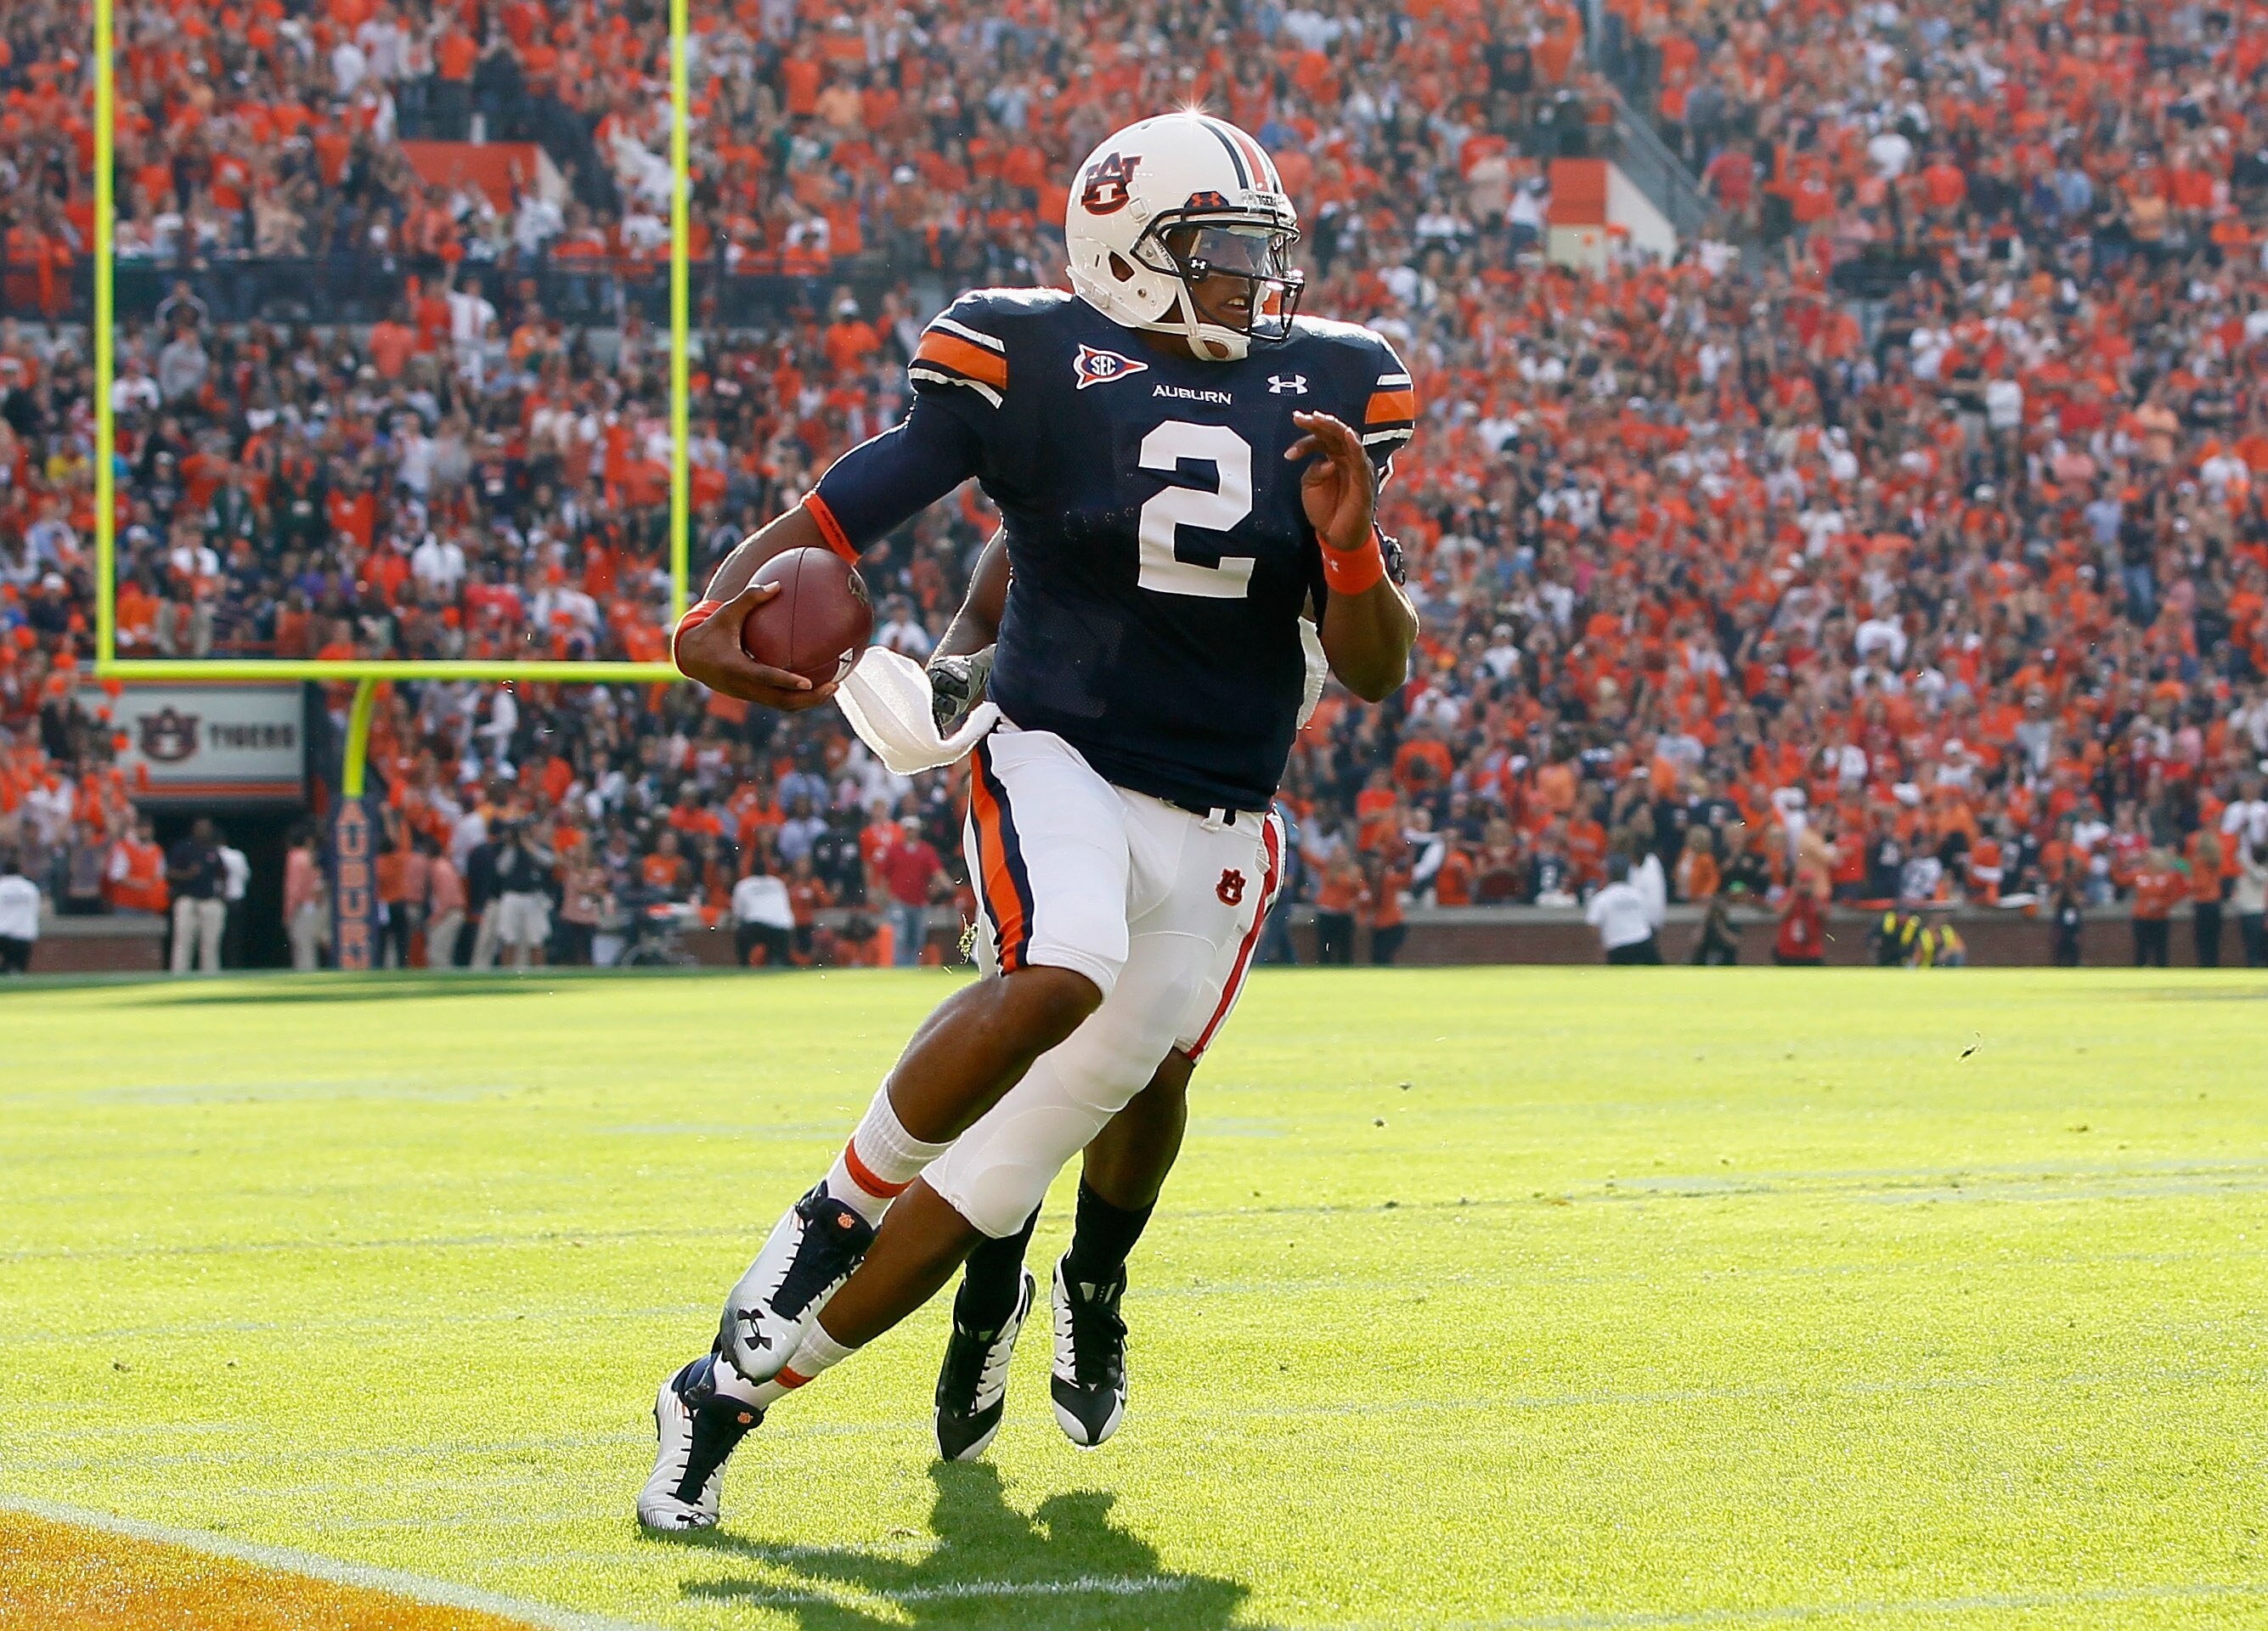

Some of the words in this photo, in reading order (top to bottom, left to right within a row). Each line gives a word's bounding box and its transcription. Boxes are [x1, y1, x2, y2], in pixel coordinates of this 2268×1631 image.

[1090, 355, 1116, 376] SEC
[1152, 385, 1233, 405] AUBURN
[1137, 420, 1255, 599] 2
